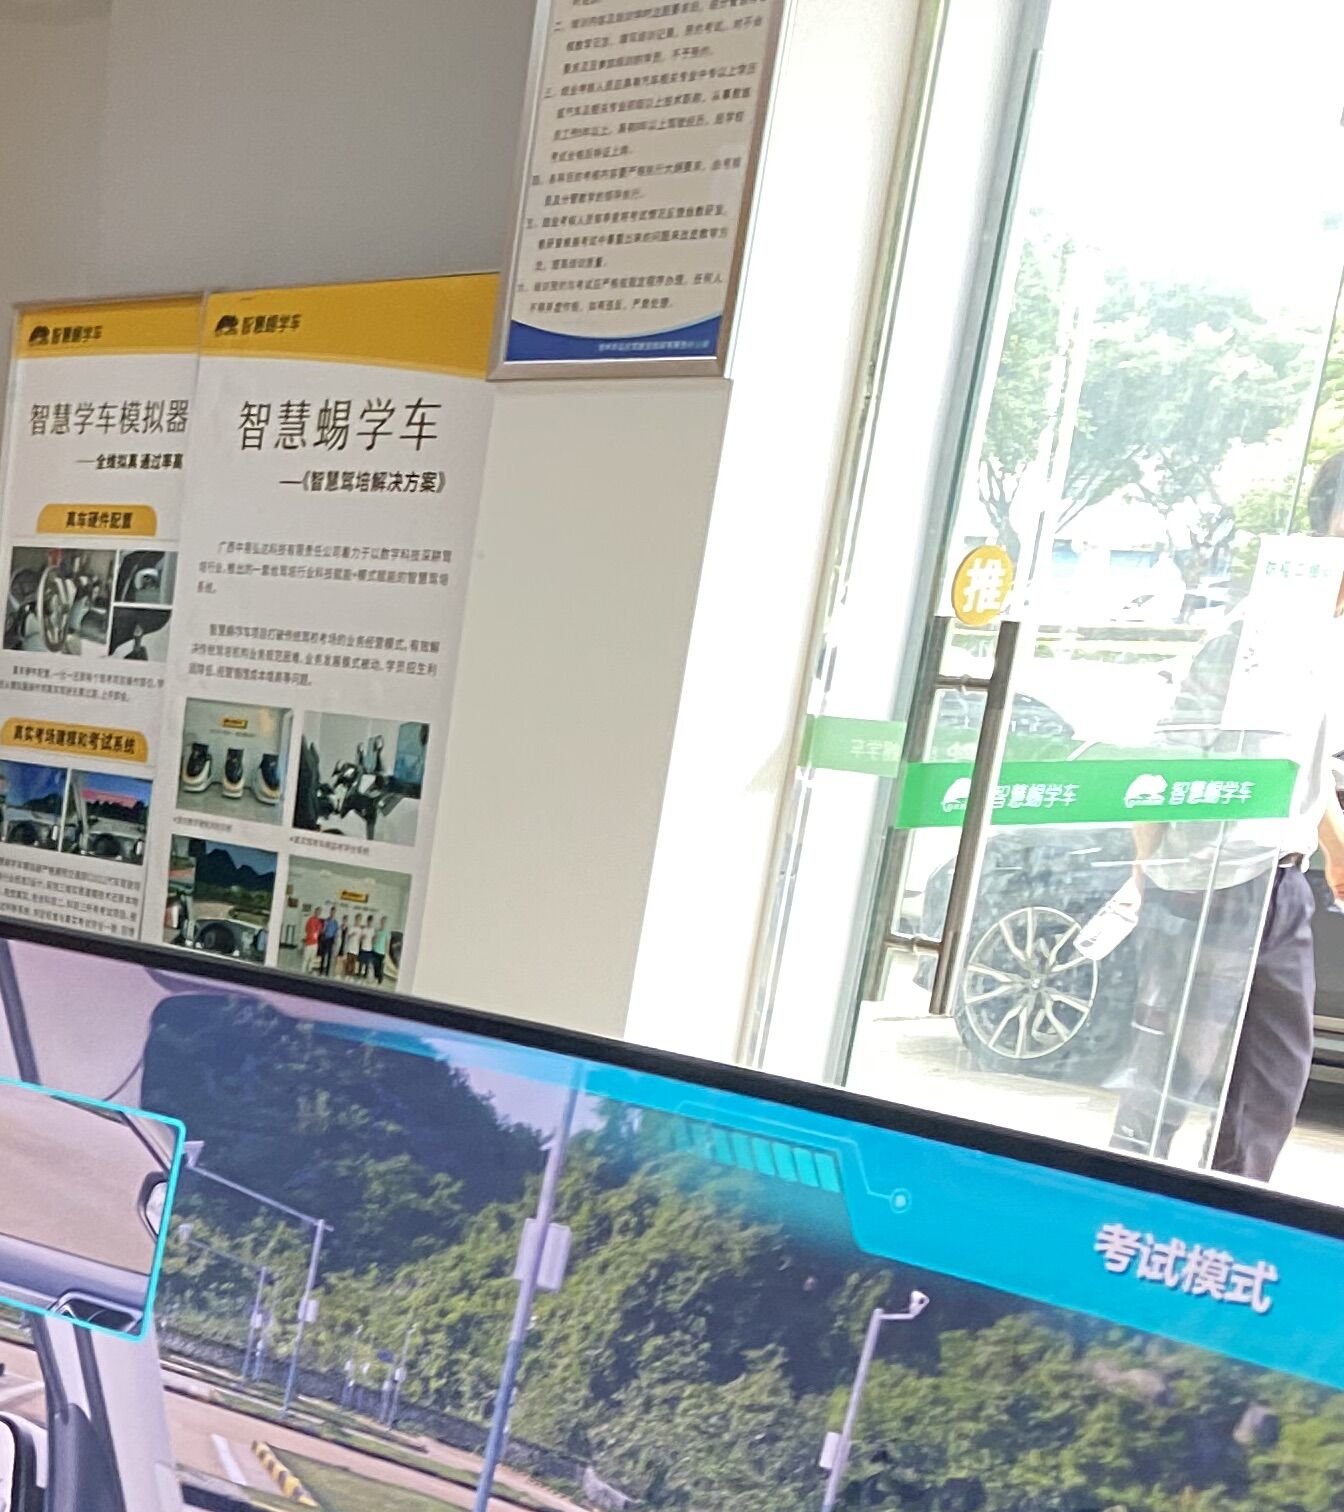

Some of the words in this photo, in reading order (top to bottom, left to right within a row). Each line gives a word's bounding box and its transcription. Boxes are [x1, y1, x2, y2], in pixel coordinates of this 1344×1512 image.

[30, 399, 189, 436] 智慧学车模拟器
[238, 397, 443, 452] 智慧蜴学车
[962, 558, 1008, 616] 推
[1093, 1222, 1279, 1314] 考试模式
